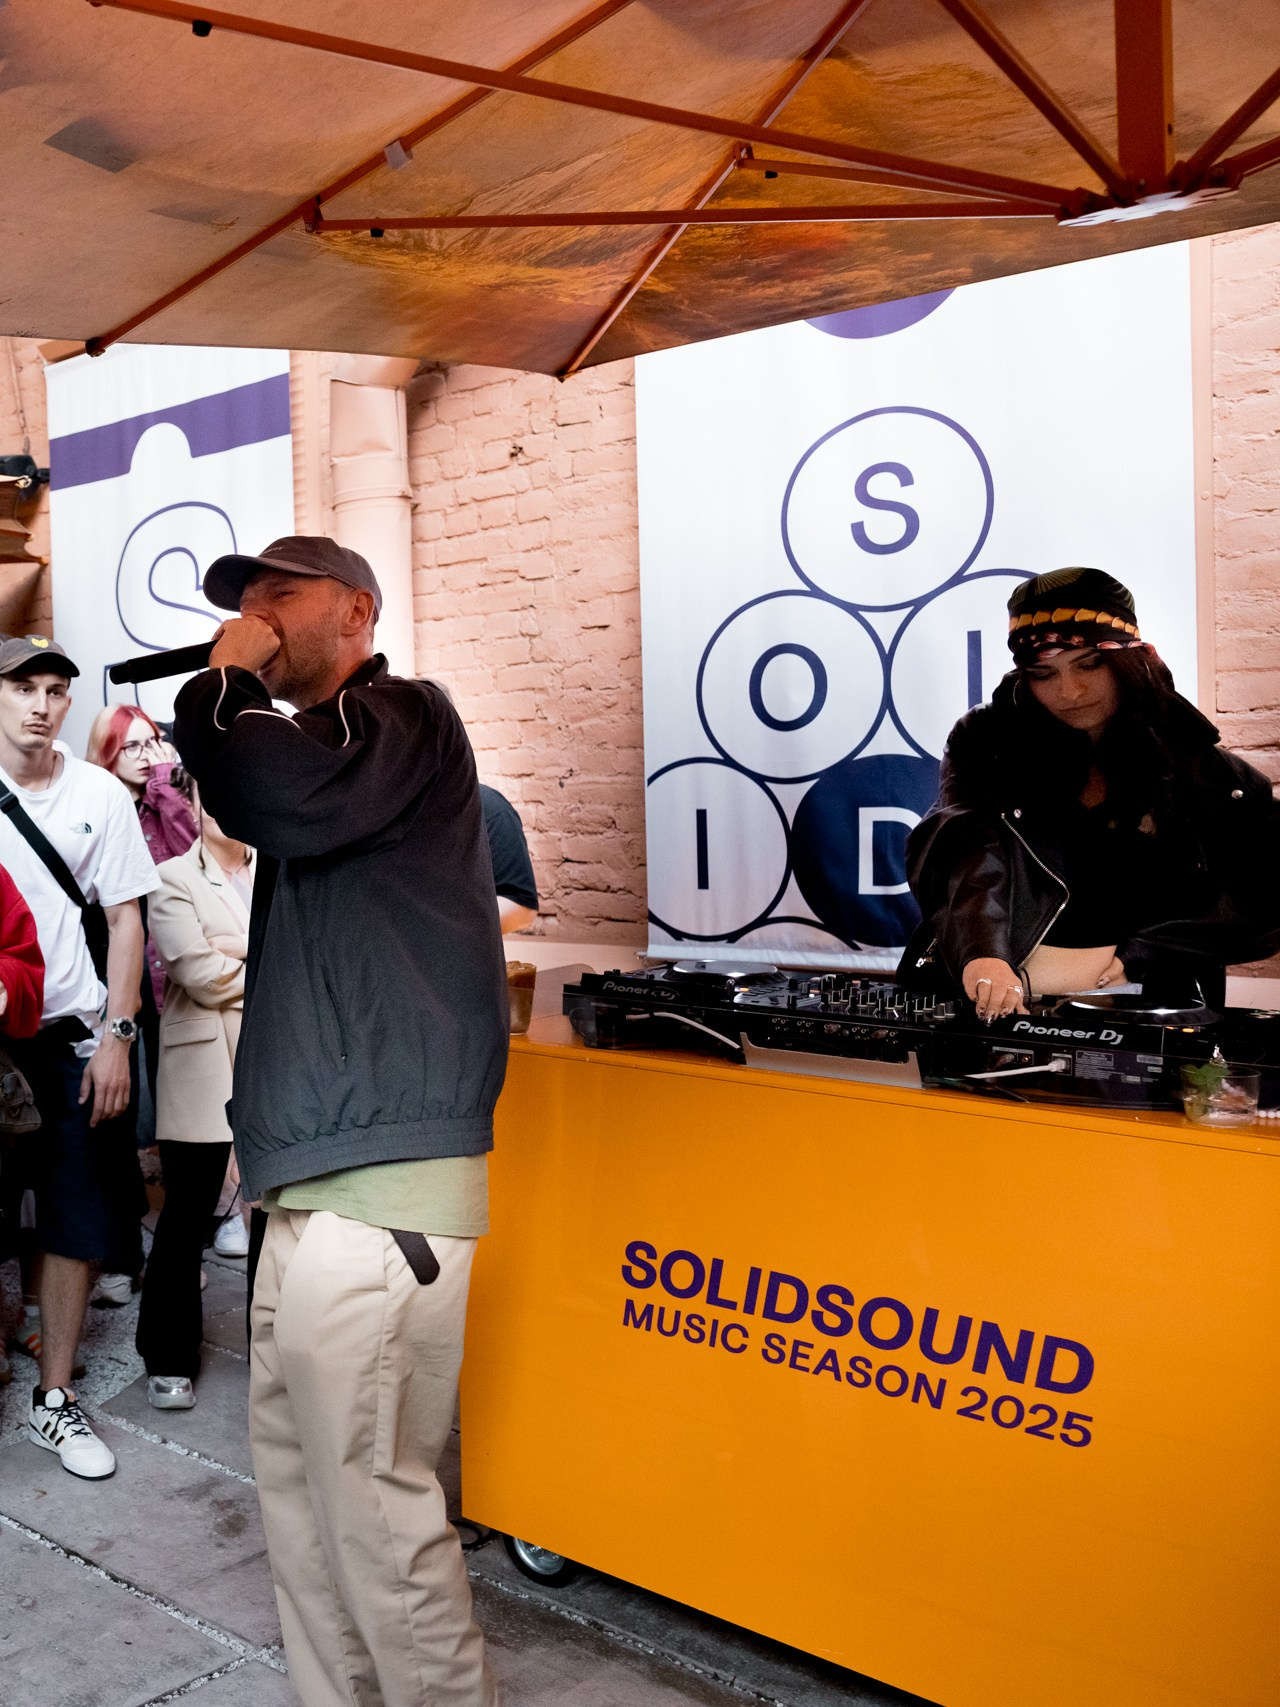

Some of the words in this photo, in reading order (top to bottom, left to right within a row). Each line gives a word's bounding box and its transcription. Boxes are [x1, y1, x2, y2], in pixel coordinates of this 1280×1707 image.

[850, 461, 921, 556] S
[748, 642, 828, 732] O
[1012, 1020, 1095, 1039] Pioneer
[1099, 1029, 1124, 1045] DJ
[620, 1240, 1095, 1395] SOLIDSOUND
[622, 1298, 750, 1354] MUSIC
[761, 1333, 948, 1410] SEASON
[956, 1385, 1094, 1448] 2025
